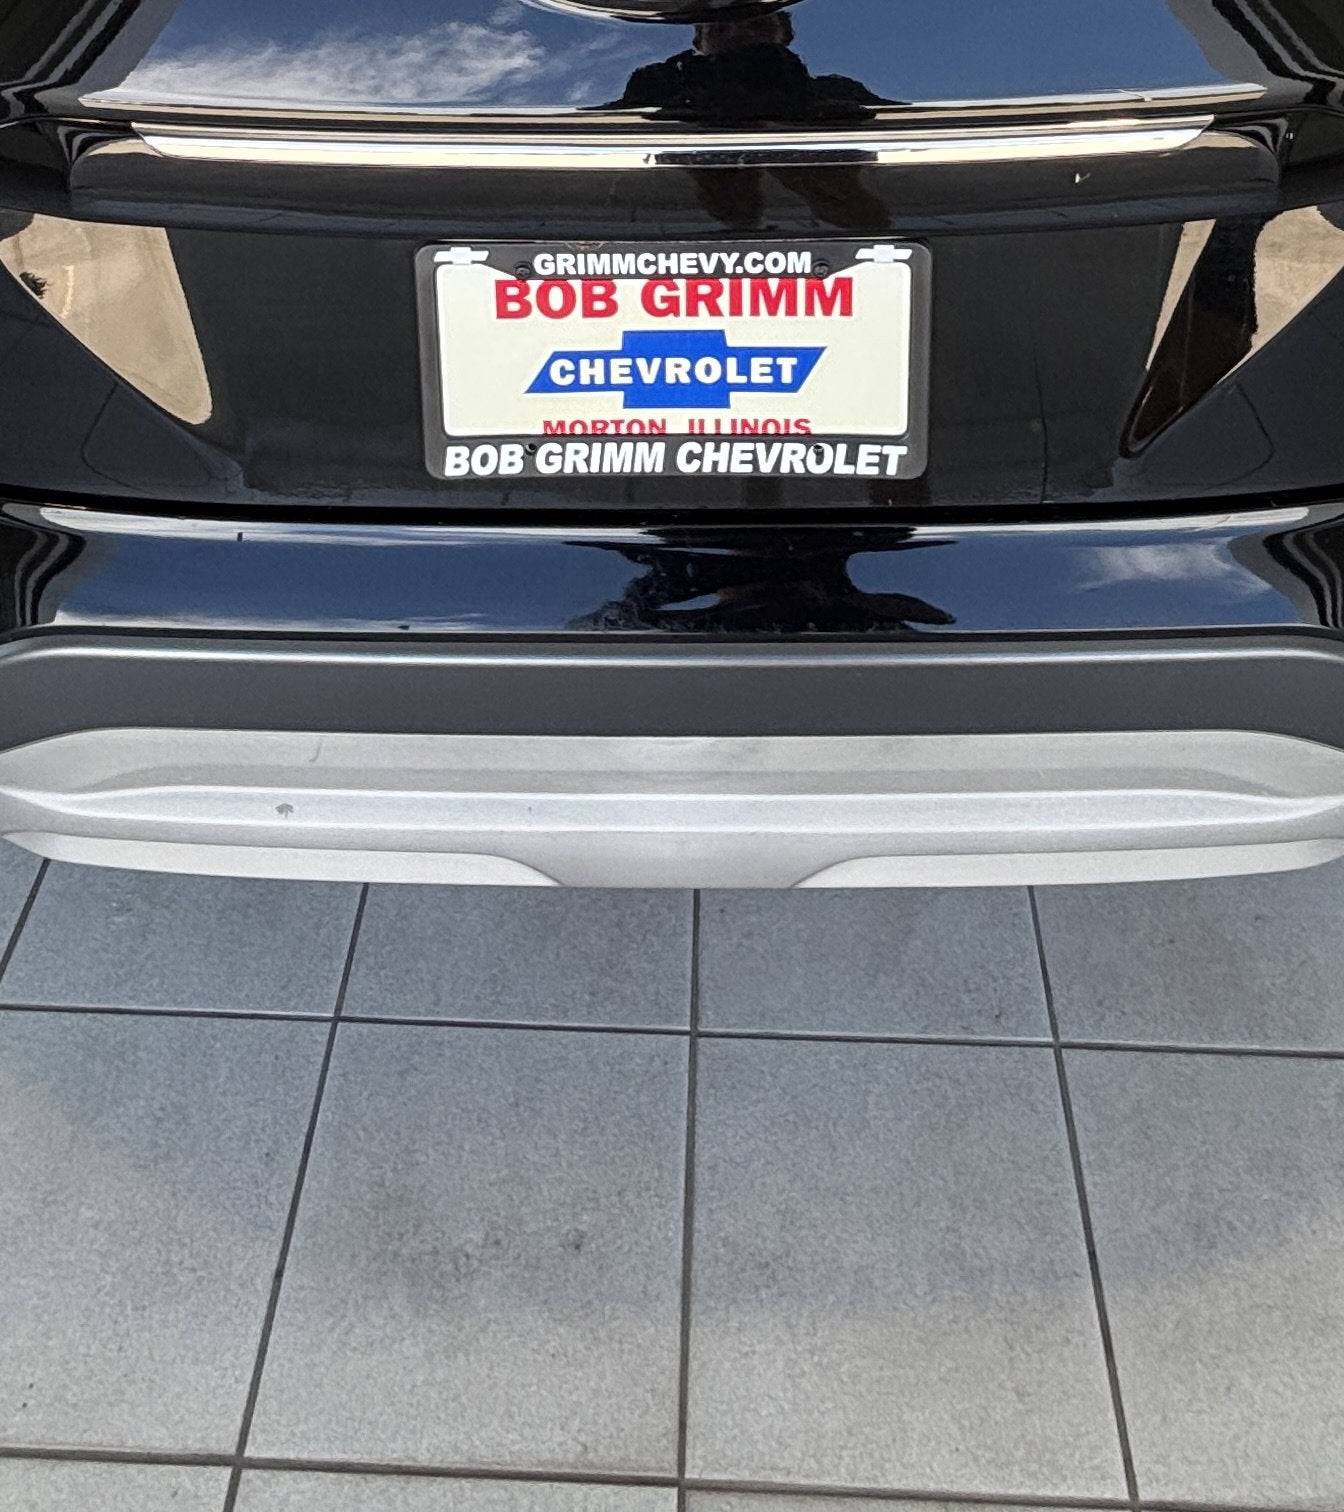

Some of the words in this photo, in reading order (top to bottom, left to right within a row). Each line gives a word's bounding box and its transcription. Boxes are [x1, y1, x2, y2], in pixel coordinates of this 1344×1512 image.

[533, 251, 812, 275] GRIMMCHEVY.COM
[495, 278, 619, 320] BOB
[640, 277, 854, 318] GRIMM
[549, 356, 799, 386] CHEVROLET
[542, 418, 667, 435] MORTON
[444, 444, 524, 477] BOB
[532, 442, 665, 475] GRIMM
[676, 442, 908, 476] CHEVROLET
